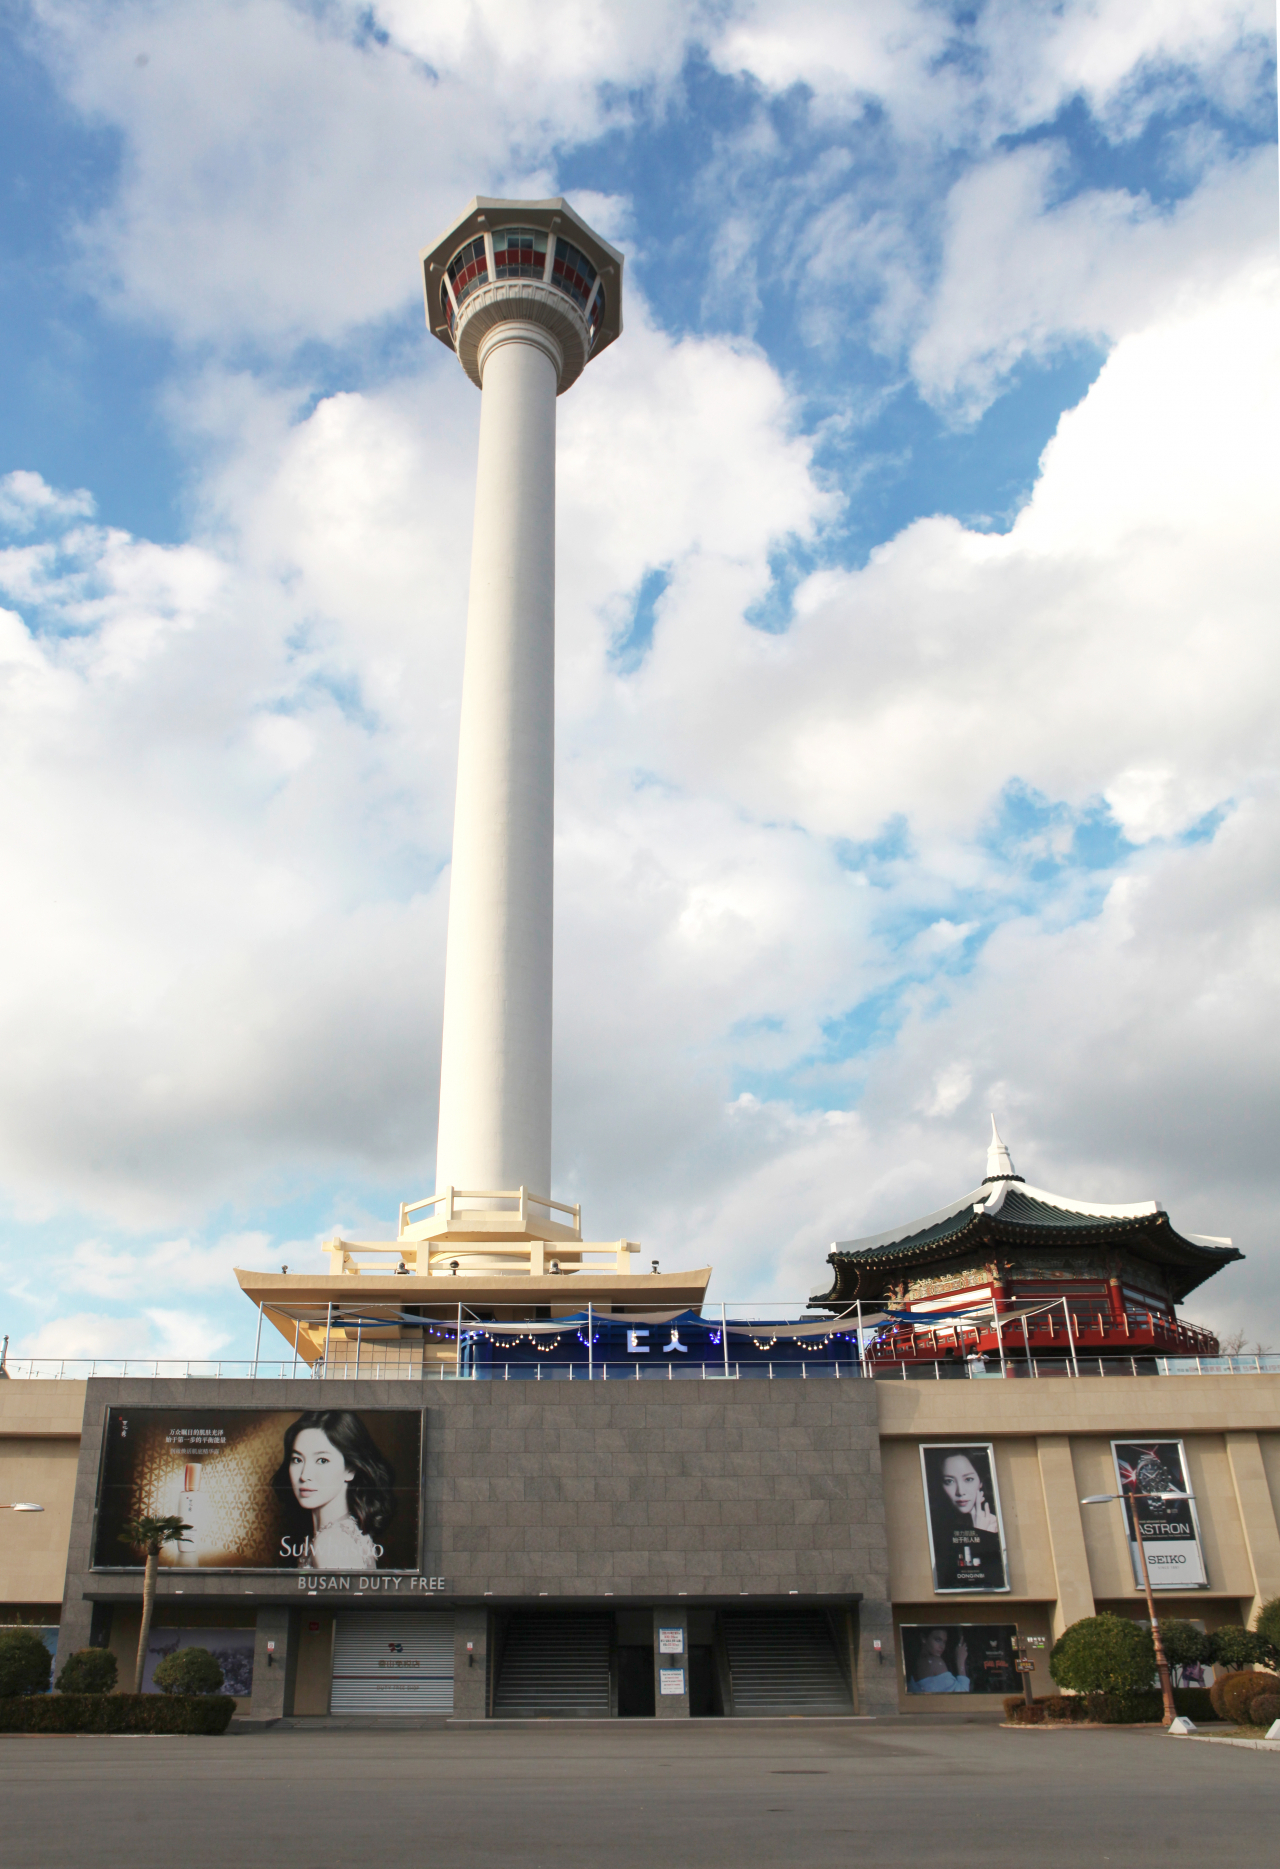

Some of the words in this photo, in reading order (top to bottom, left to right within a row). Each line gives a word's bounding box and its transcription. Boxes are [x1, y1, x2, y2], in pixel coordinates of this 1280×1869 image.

[1147, 1554, 1187, 1565] SEIKO
[298, 1577, 350, 1590] BUSAN
[359, 1577, 402, 1590] DUTY
[410, 1577, 445, 1590] FREE
